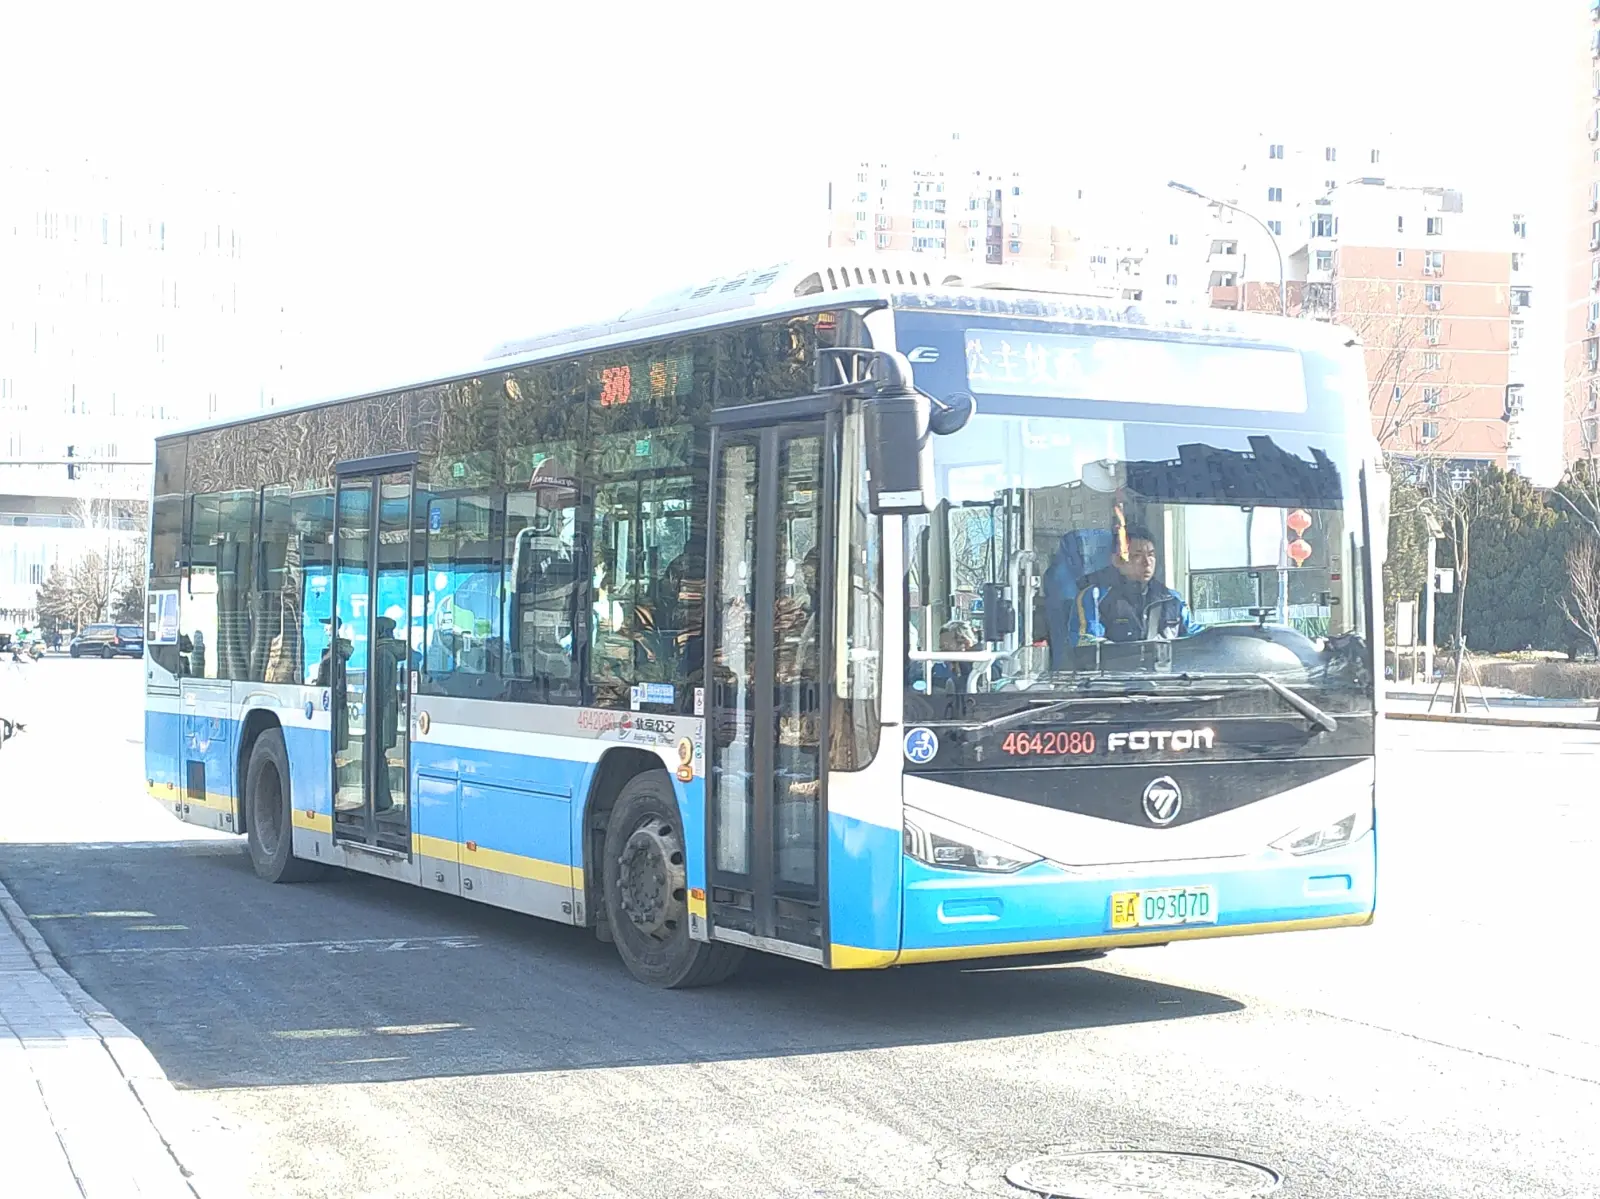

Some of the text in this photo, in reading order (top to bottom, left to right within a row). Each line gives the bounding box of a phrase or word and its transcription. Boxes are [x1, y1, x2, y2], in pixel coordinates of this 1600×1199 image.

[634, 717, 676, 734] 北京公交
[1002, 731, 1095, 755] 4642080
[1108, 727, 1214, 751] FOTON
